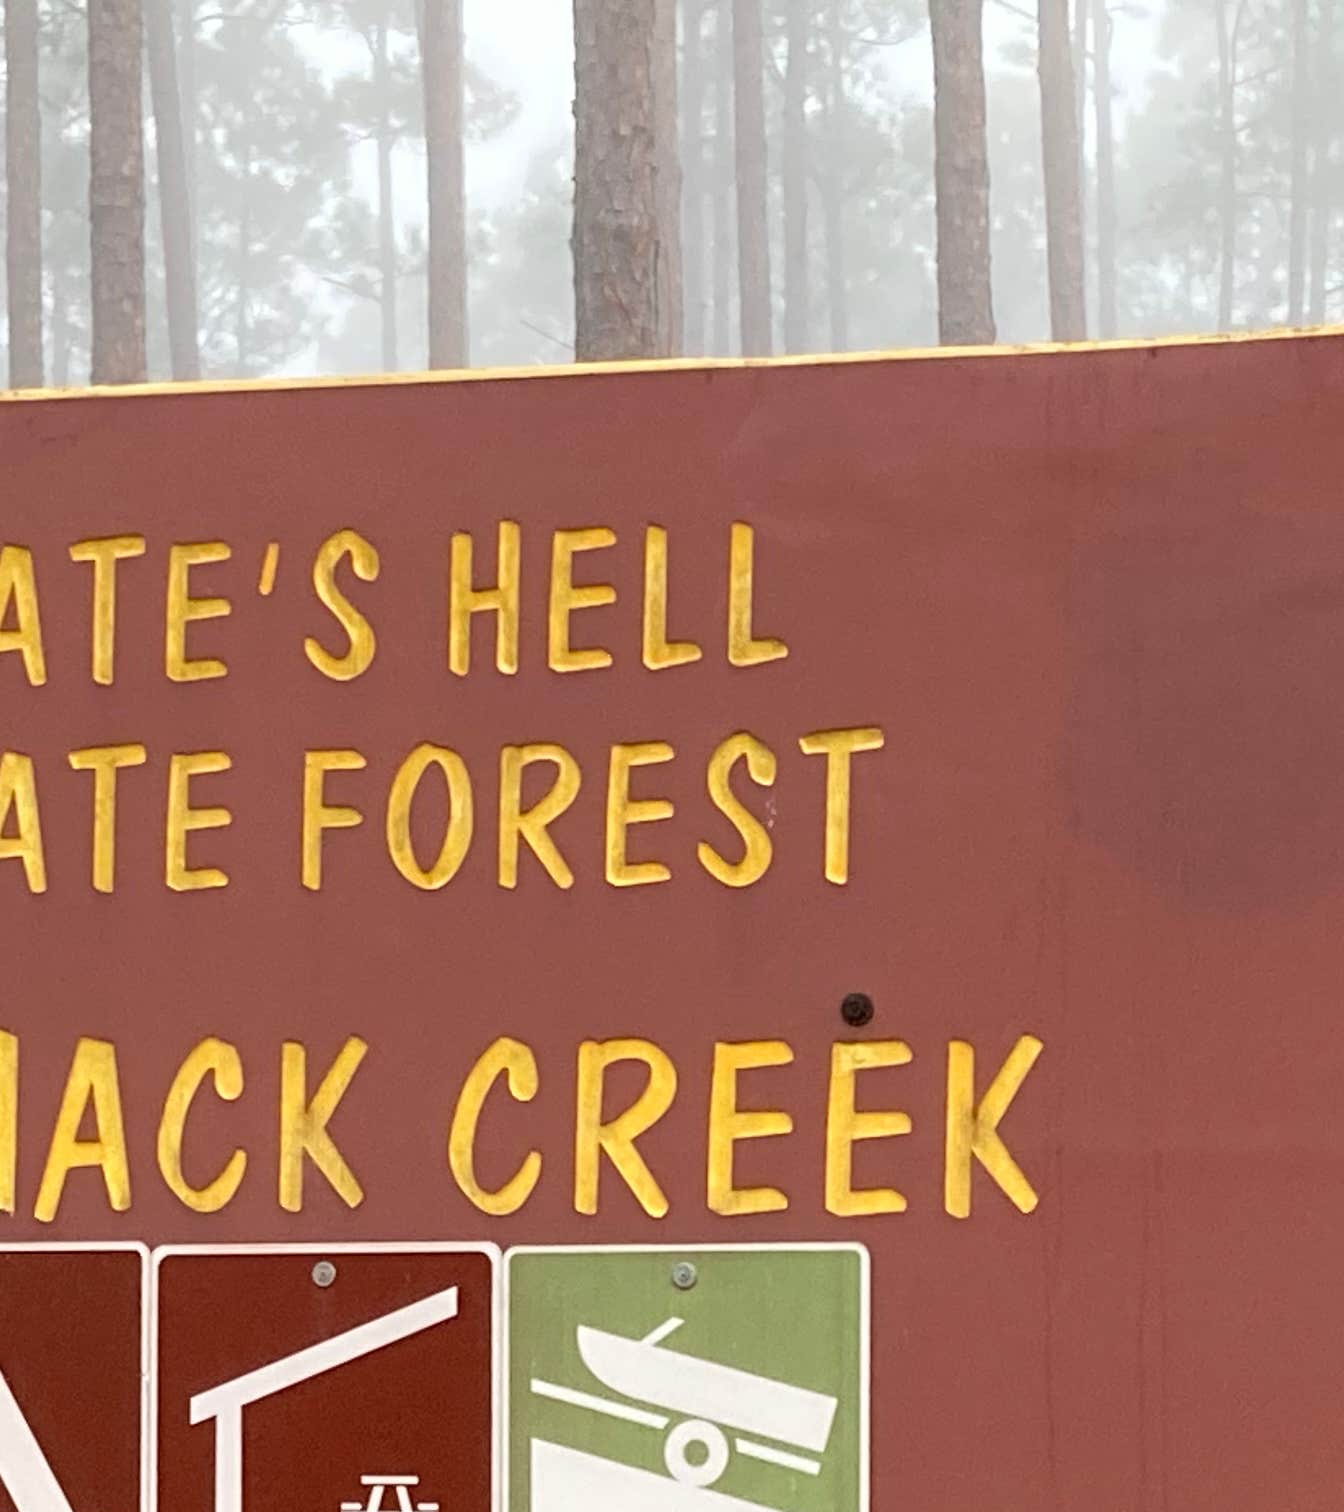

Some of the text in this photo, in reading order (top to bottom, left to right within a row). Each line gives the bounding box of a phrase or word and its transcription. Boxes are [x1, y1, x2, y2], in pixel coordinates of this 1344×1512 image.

[448, 521, 788, 676] HELL
[302, 728, 883, 890] FOREST
[448, 1035, 1042, 1219] CREEK
